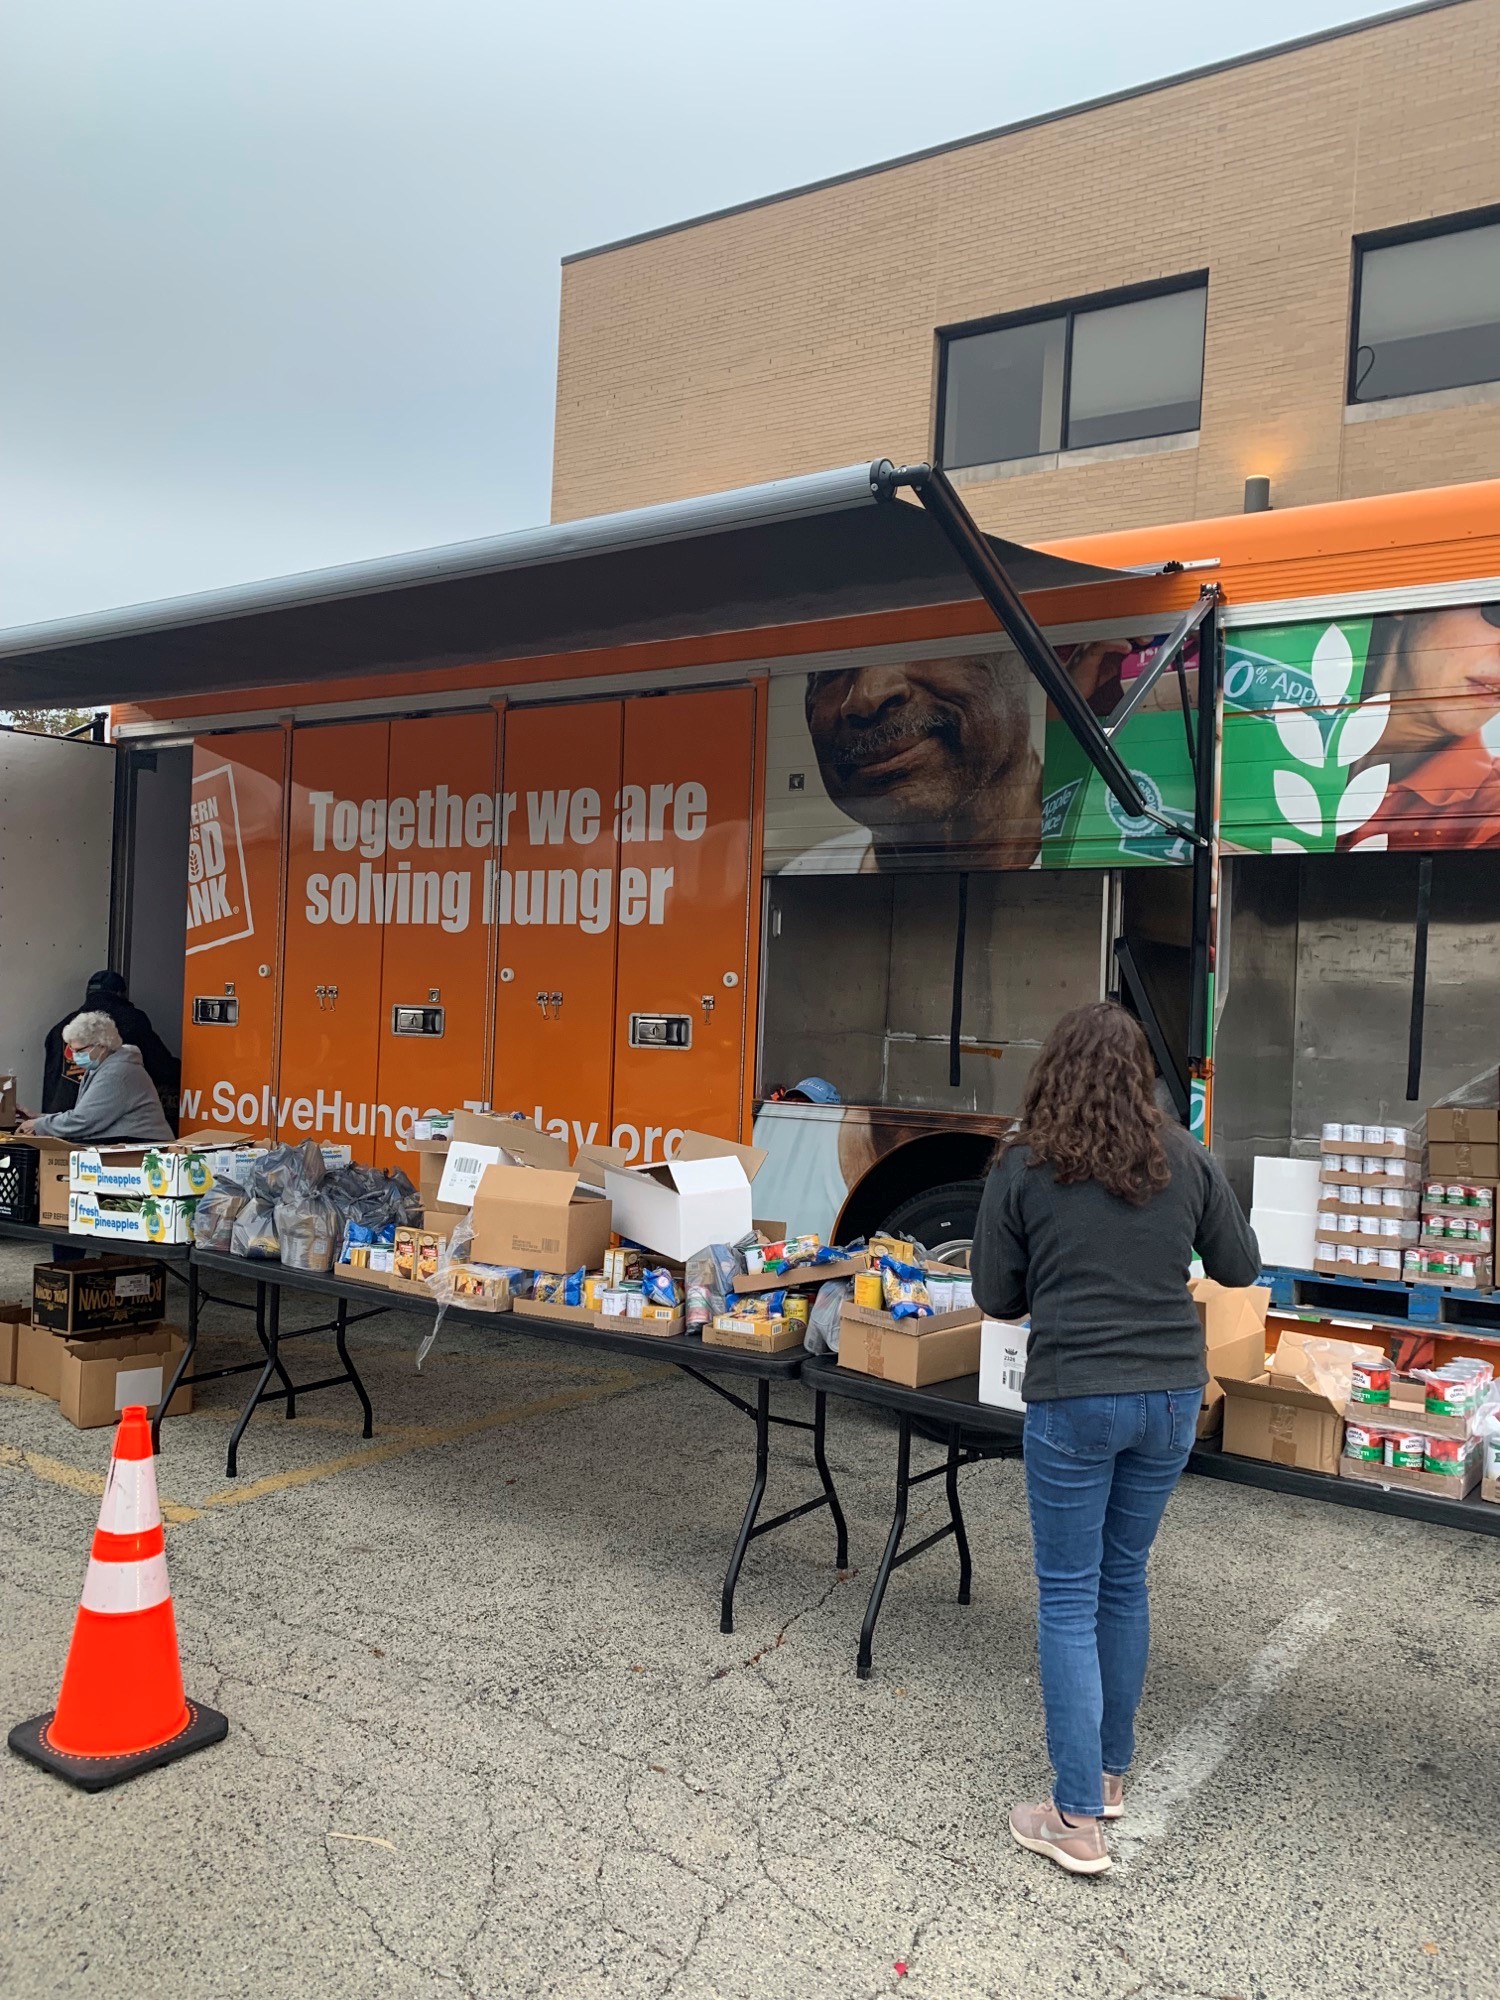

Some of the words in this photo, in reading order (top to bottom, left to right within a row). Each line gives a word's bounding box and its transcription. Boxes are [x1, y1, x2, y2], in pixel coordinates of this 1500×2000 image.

[190, 796, 219, 826] ERN
[308, 784, 517, 859] Together
[526, 787, 601, 846] we
[613, 781, 708, 844] are
[305, 861, 472, 934] solving
[482, 859, 674, 935] hunger
[80, 1162, 102, 1174] fresh
[97, 1172, 142, 1188] pineapples
[78, 1204, 100, 1217] fresh
[94, 1216, 139, 1232] pineapples
